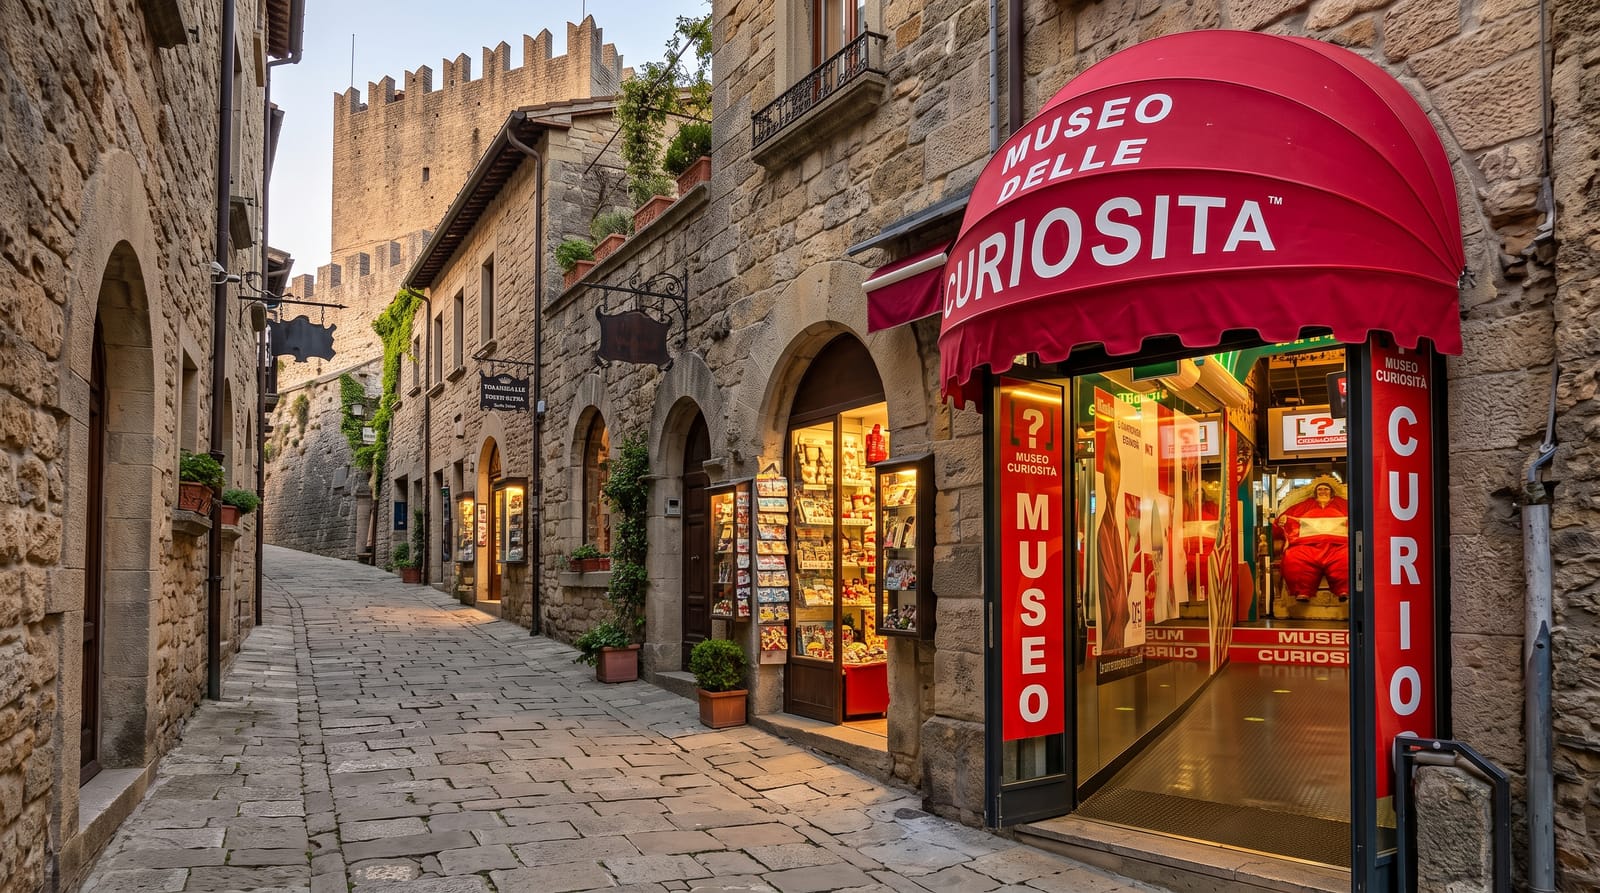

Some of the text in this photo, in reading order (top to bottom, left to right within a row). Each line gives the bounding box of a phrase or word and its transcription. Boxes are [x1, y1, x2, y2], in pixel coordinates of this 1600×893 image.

[1001, 93, 1173, 174] MUSEO
[996, 138, 1148, 205] DELLE
[1376, 369, 1427, 389] CURIOSITÀ
[1385, 357, 1418, 373] MUSEO
[1015, 452, 1049, 464] MUSEO
[1016, 492, 1049, 723] MUSEO
[1388, 405, 1422, 774] CURIO
[1278, 631, 1350, 645] MUSE
